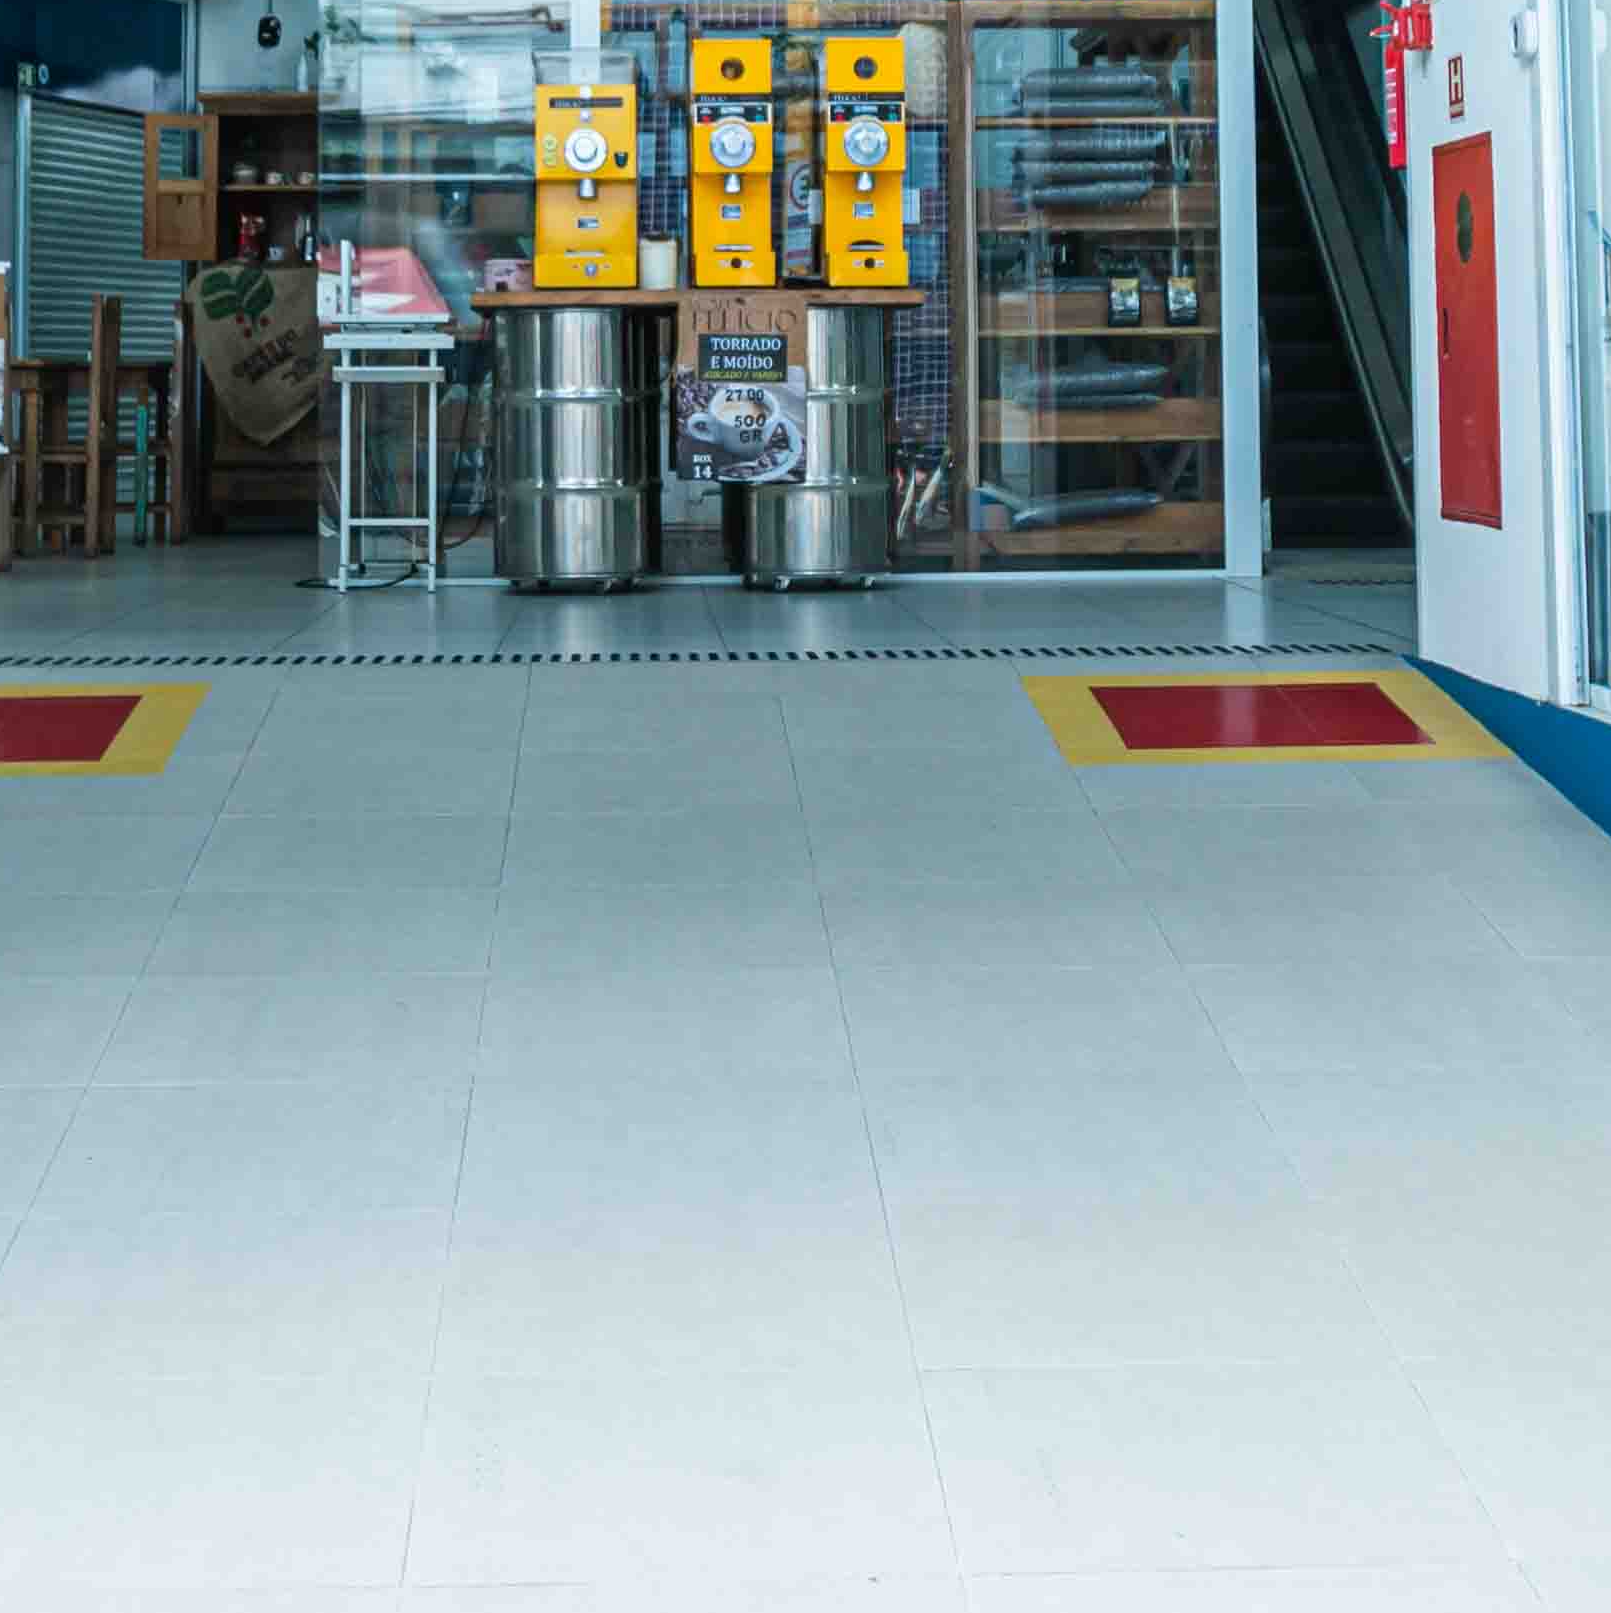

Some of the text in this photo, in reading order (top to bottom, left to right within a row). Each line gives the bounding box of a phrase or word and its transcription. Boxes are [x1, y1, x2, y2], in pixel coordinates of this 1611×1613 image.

[711, 337, 782, 351] TORRADO
[711, 354, 773, 369] E MOÍDO
[692, 466, 713, 479] 14
